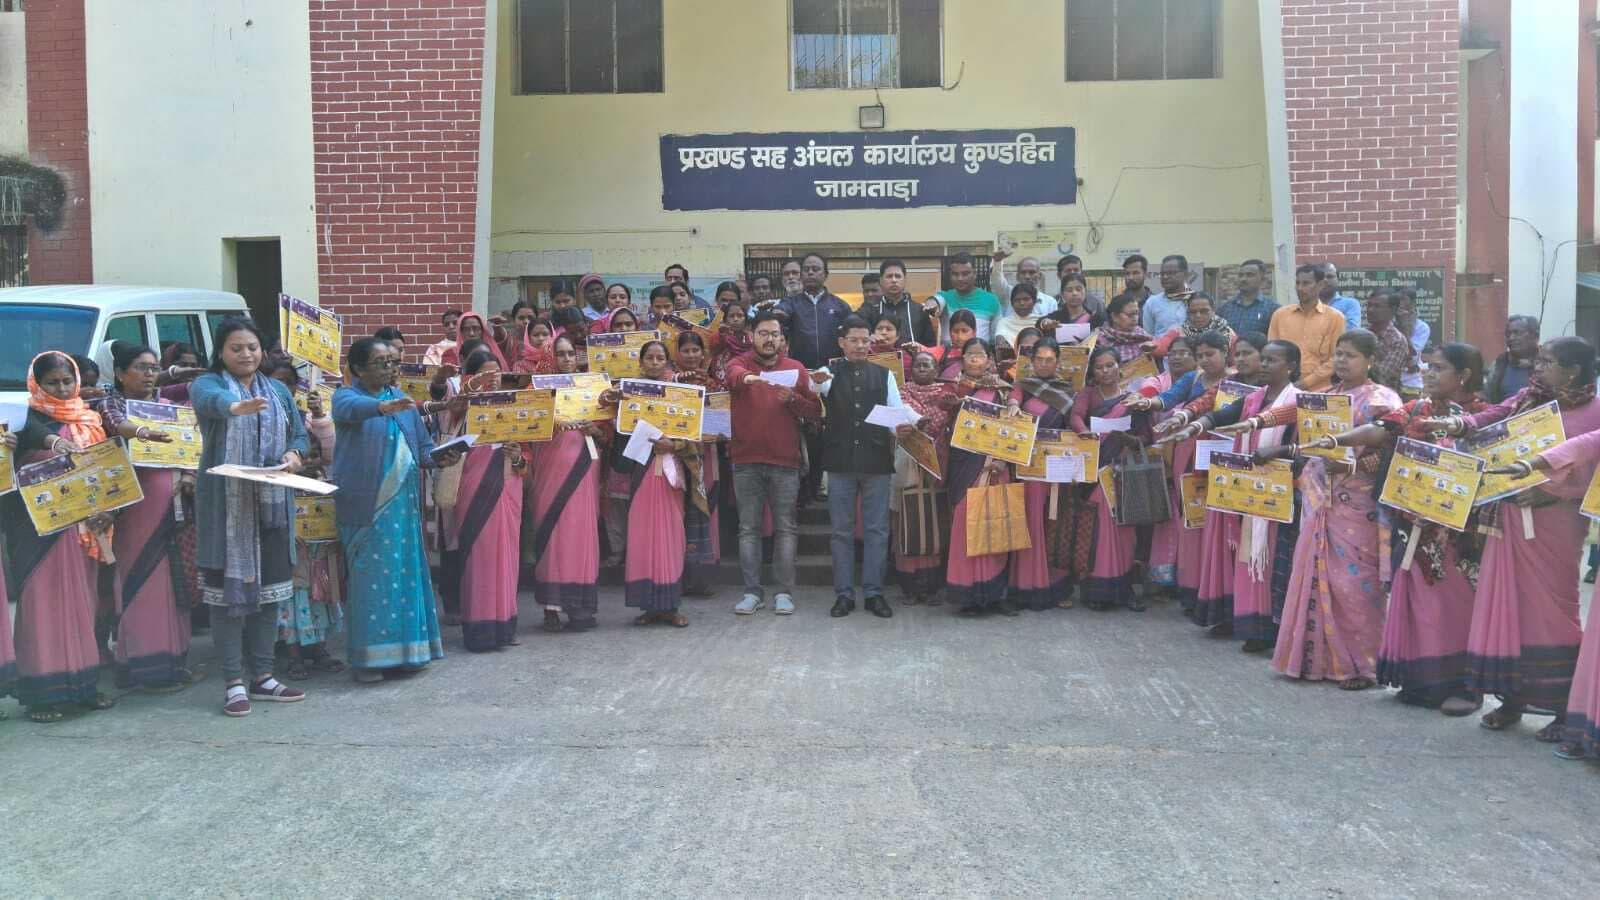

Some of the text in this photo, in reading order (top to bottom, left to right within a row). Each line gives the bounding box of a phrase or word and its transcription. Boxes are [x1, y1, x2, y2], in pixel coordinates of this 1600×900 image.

[678, 132, 1056, 174] प्रखण्ड सह अंचल कार्यालय कुण्डहित
[814, 180, 920, 202] जामताड़ा
